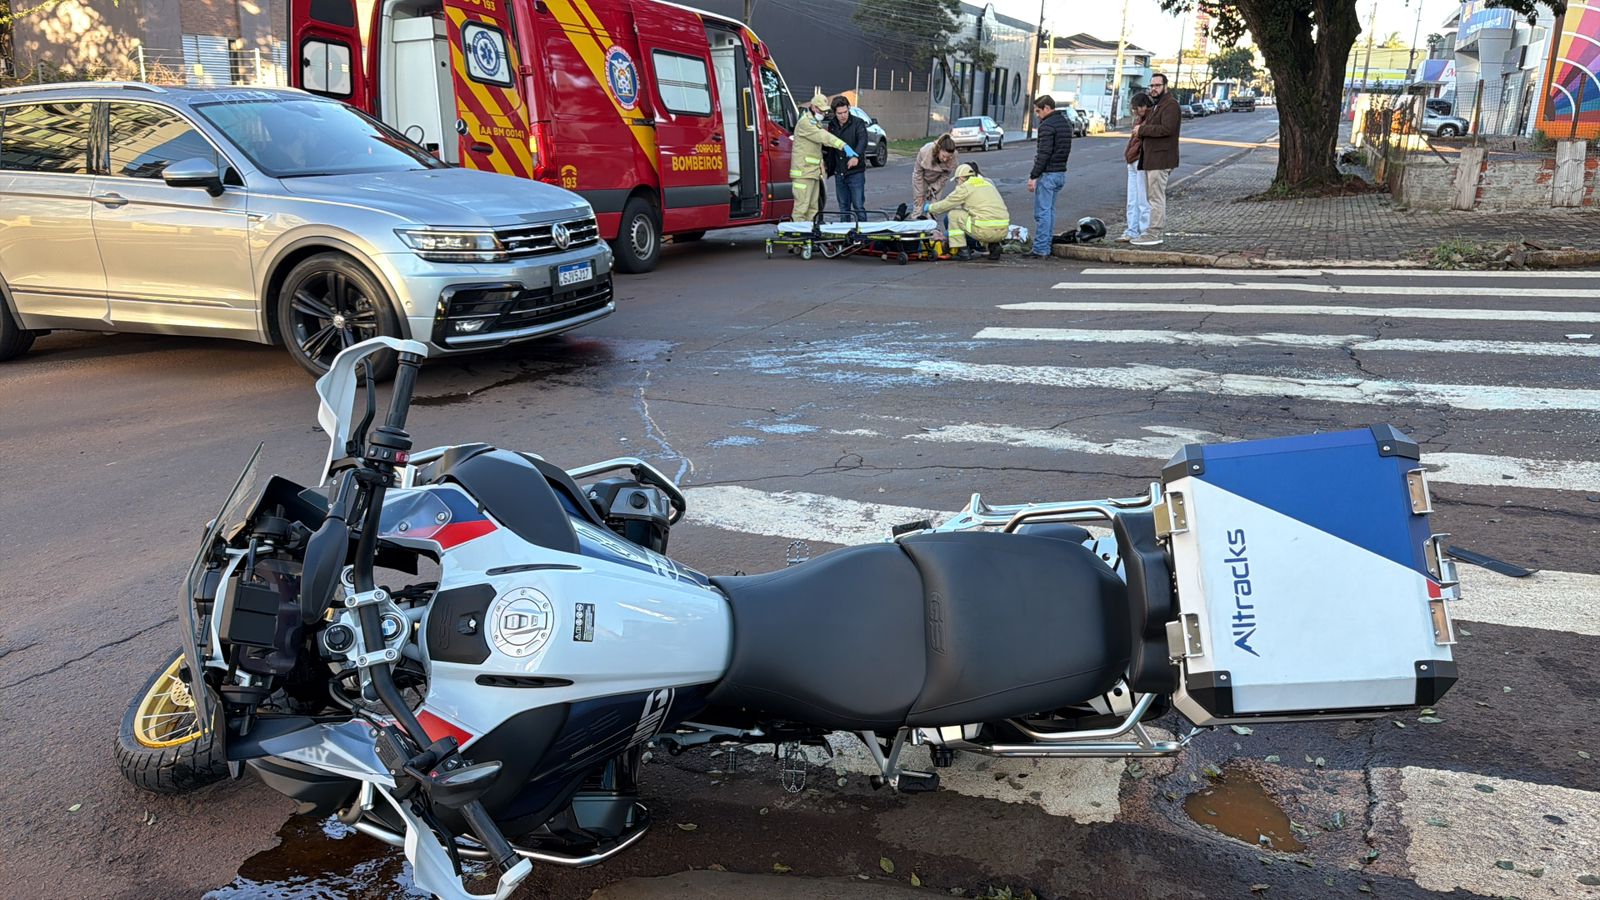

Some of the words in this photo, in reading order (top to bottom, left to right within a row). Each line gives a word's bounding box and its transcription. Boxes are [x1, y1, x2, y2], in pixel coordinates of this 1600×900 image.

[480, 126, 492, 135] AA
[493, 127, 505, 137] BM
[505, 128, 525, 139] 00141
[695, 144, 714, 153] CORPO
[714, 144, 721, 153] DE
[671, 155, 723, 171] BOMBEIROS
[562, 177, 577, 189] 193
[1223, 528, 1261, 658] Altracks
